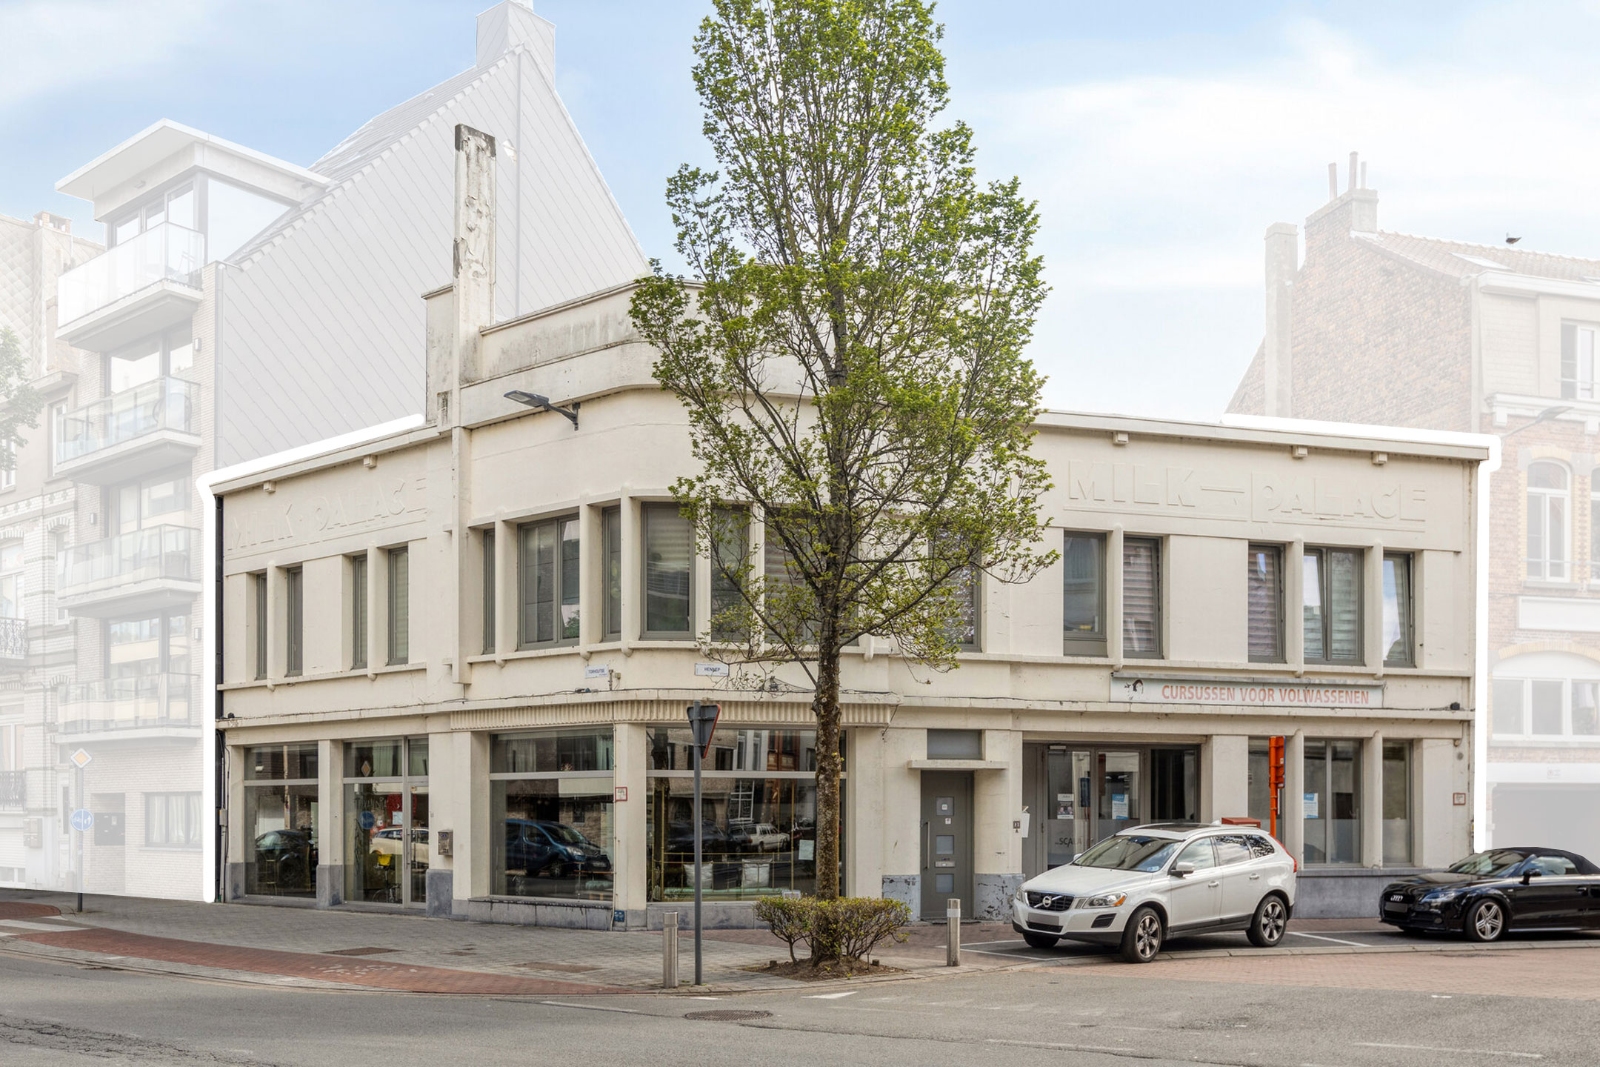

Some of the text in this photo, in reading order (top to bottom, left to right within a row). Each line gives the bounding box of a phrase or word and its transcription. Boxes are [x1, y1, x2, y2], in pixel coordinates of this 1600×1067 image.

[1067, 459, 1196, 508] MILK
[1250, 469, 1427, 523] PALACE
[1161, 684, 1370, 705] CURSUSSEN VOOR VOLWASSENEN
